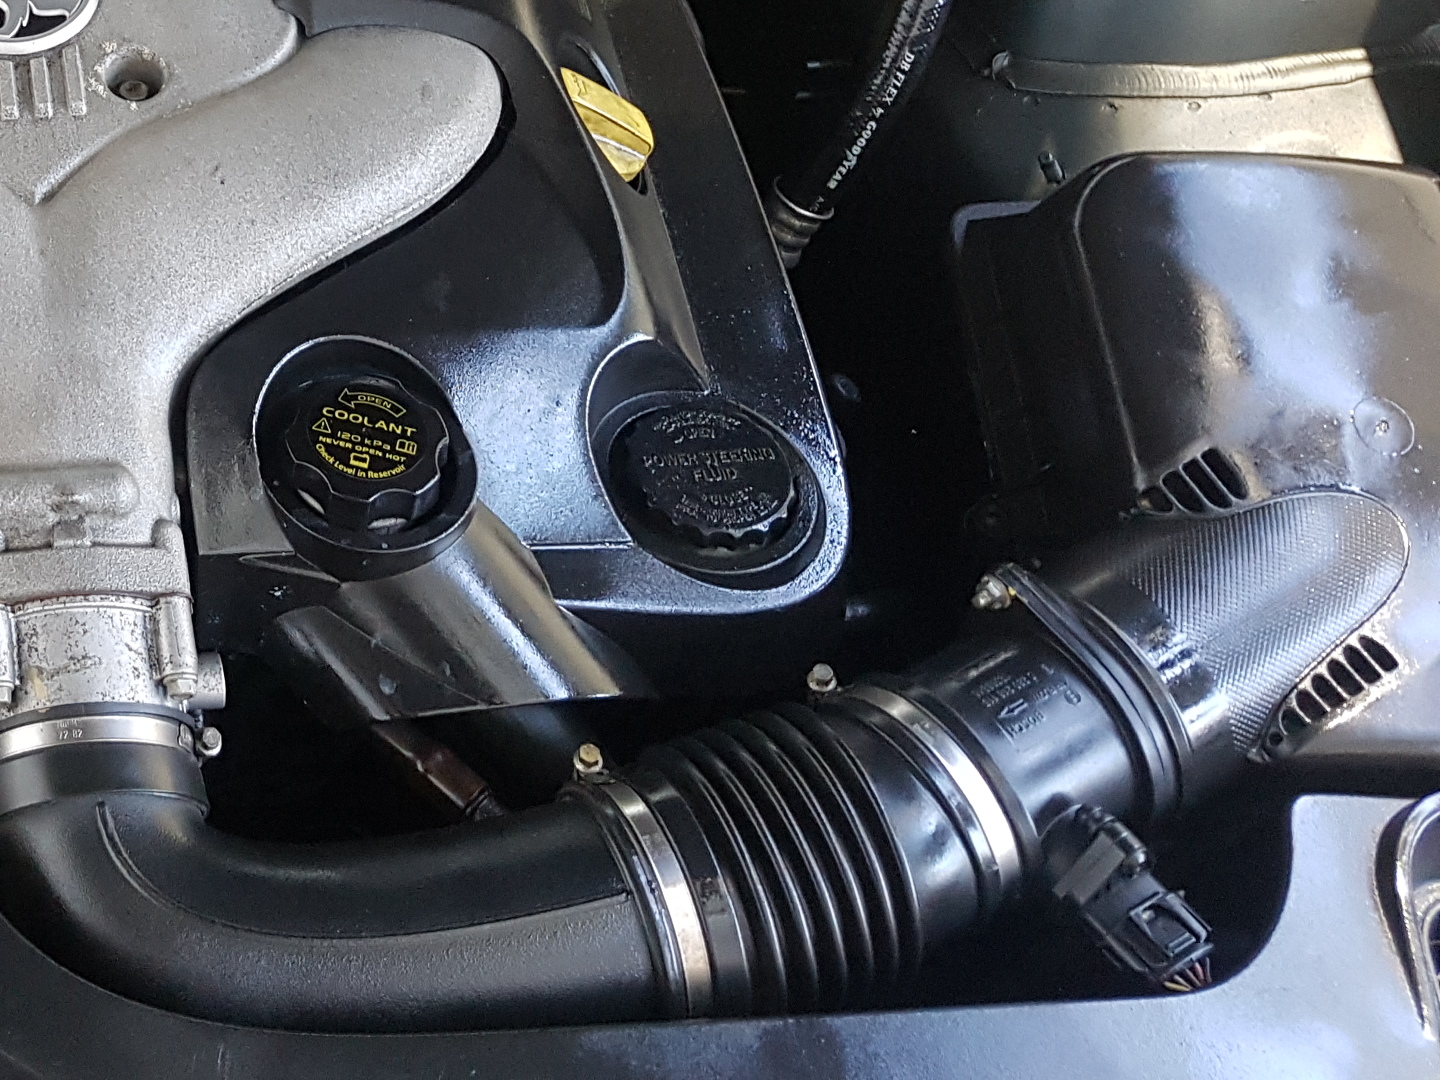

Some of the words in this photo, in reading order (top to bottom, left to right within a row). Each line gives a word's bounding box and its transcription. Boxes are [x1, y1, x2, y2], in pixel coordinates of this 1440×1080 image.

[882, 71, 906, 106] FLEX
[826, 120, 877, 189] GOODYEAR
[357, 395, 392, 409] OPEN
[322, 407, 417, 437] COOLANT
[319, 436, 353, 449] NEVER
[355, 445, 383, 457] OPEN
[386, 453, 406, 462] HOT
[337, 431, 361, 442] 120
[364, 438, 391, 450] kPa
[316, 443, 335, 464] Check
[335, 460, 356, 475] Level
[358, 469, 366, 478] in
[368, 464, 406, 479] Reservoir
[643, 454, 698, 468] POWER
[701, 447, 776, 466] STEERING
[694, 468, 738, 482] FLUID
